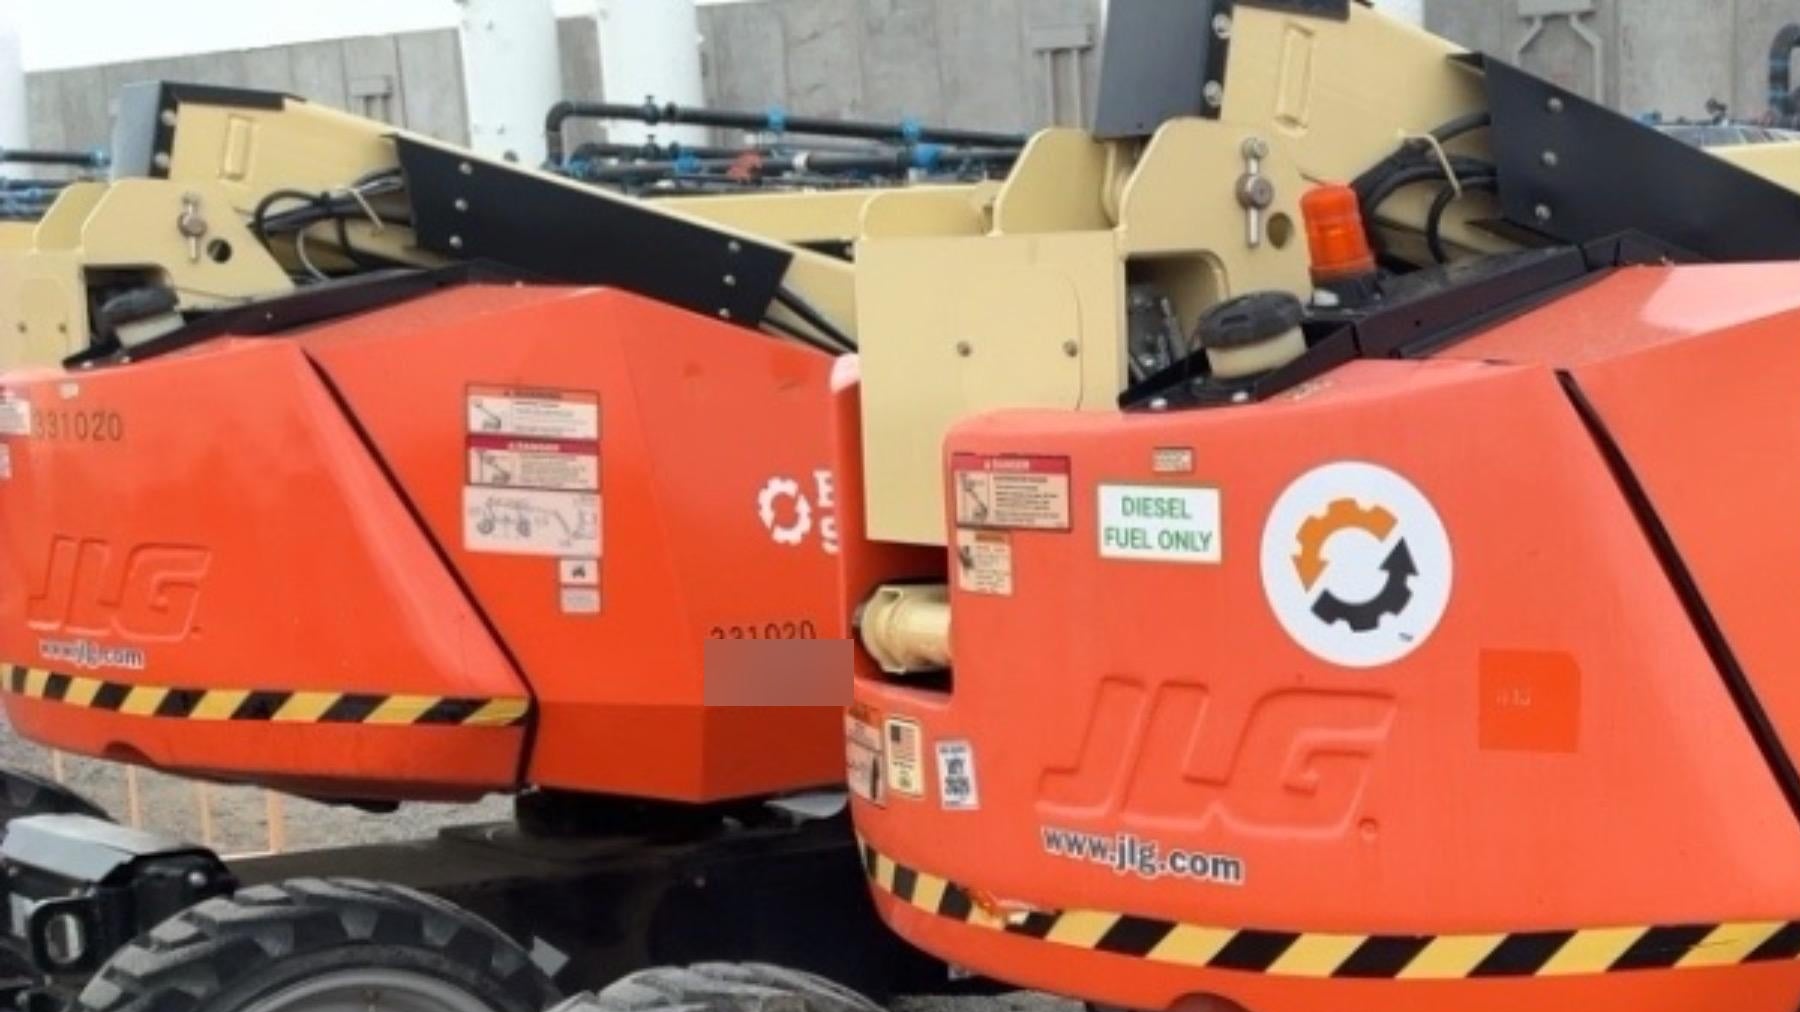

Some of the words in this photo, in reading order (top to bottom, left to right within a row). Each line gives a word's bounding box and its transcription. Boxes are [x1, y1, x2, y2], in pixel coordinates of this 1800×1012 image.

[1121, 496, 1193, 520] DIESEL
[1103, 527, 1151, 550] FUEL
[1157, 530, 1213, 553] ONLY
[1035, 674, 1398, 840] JLG
[1043, 829, 1244, 884] www.jlg.com
